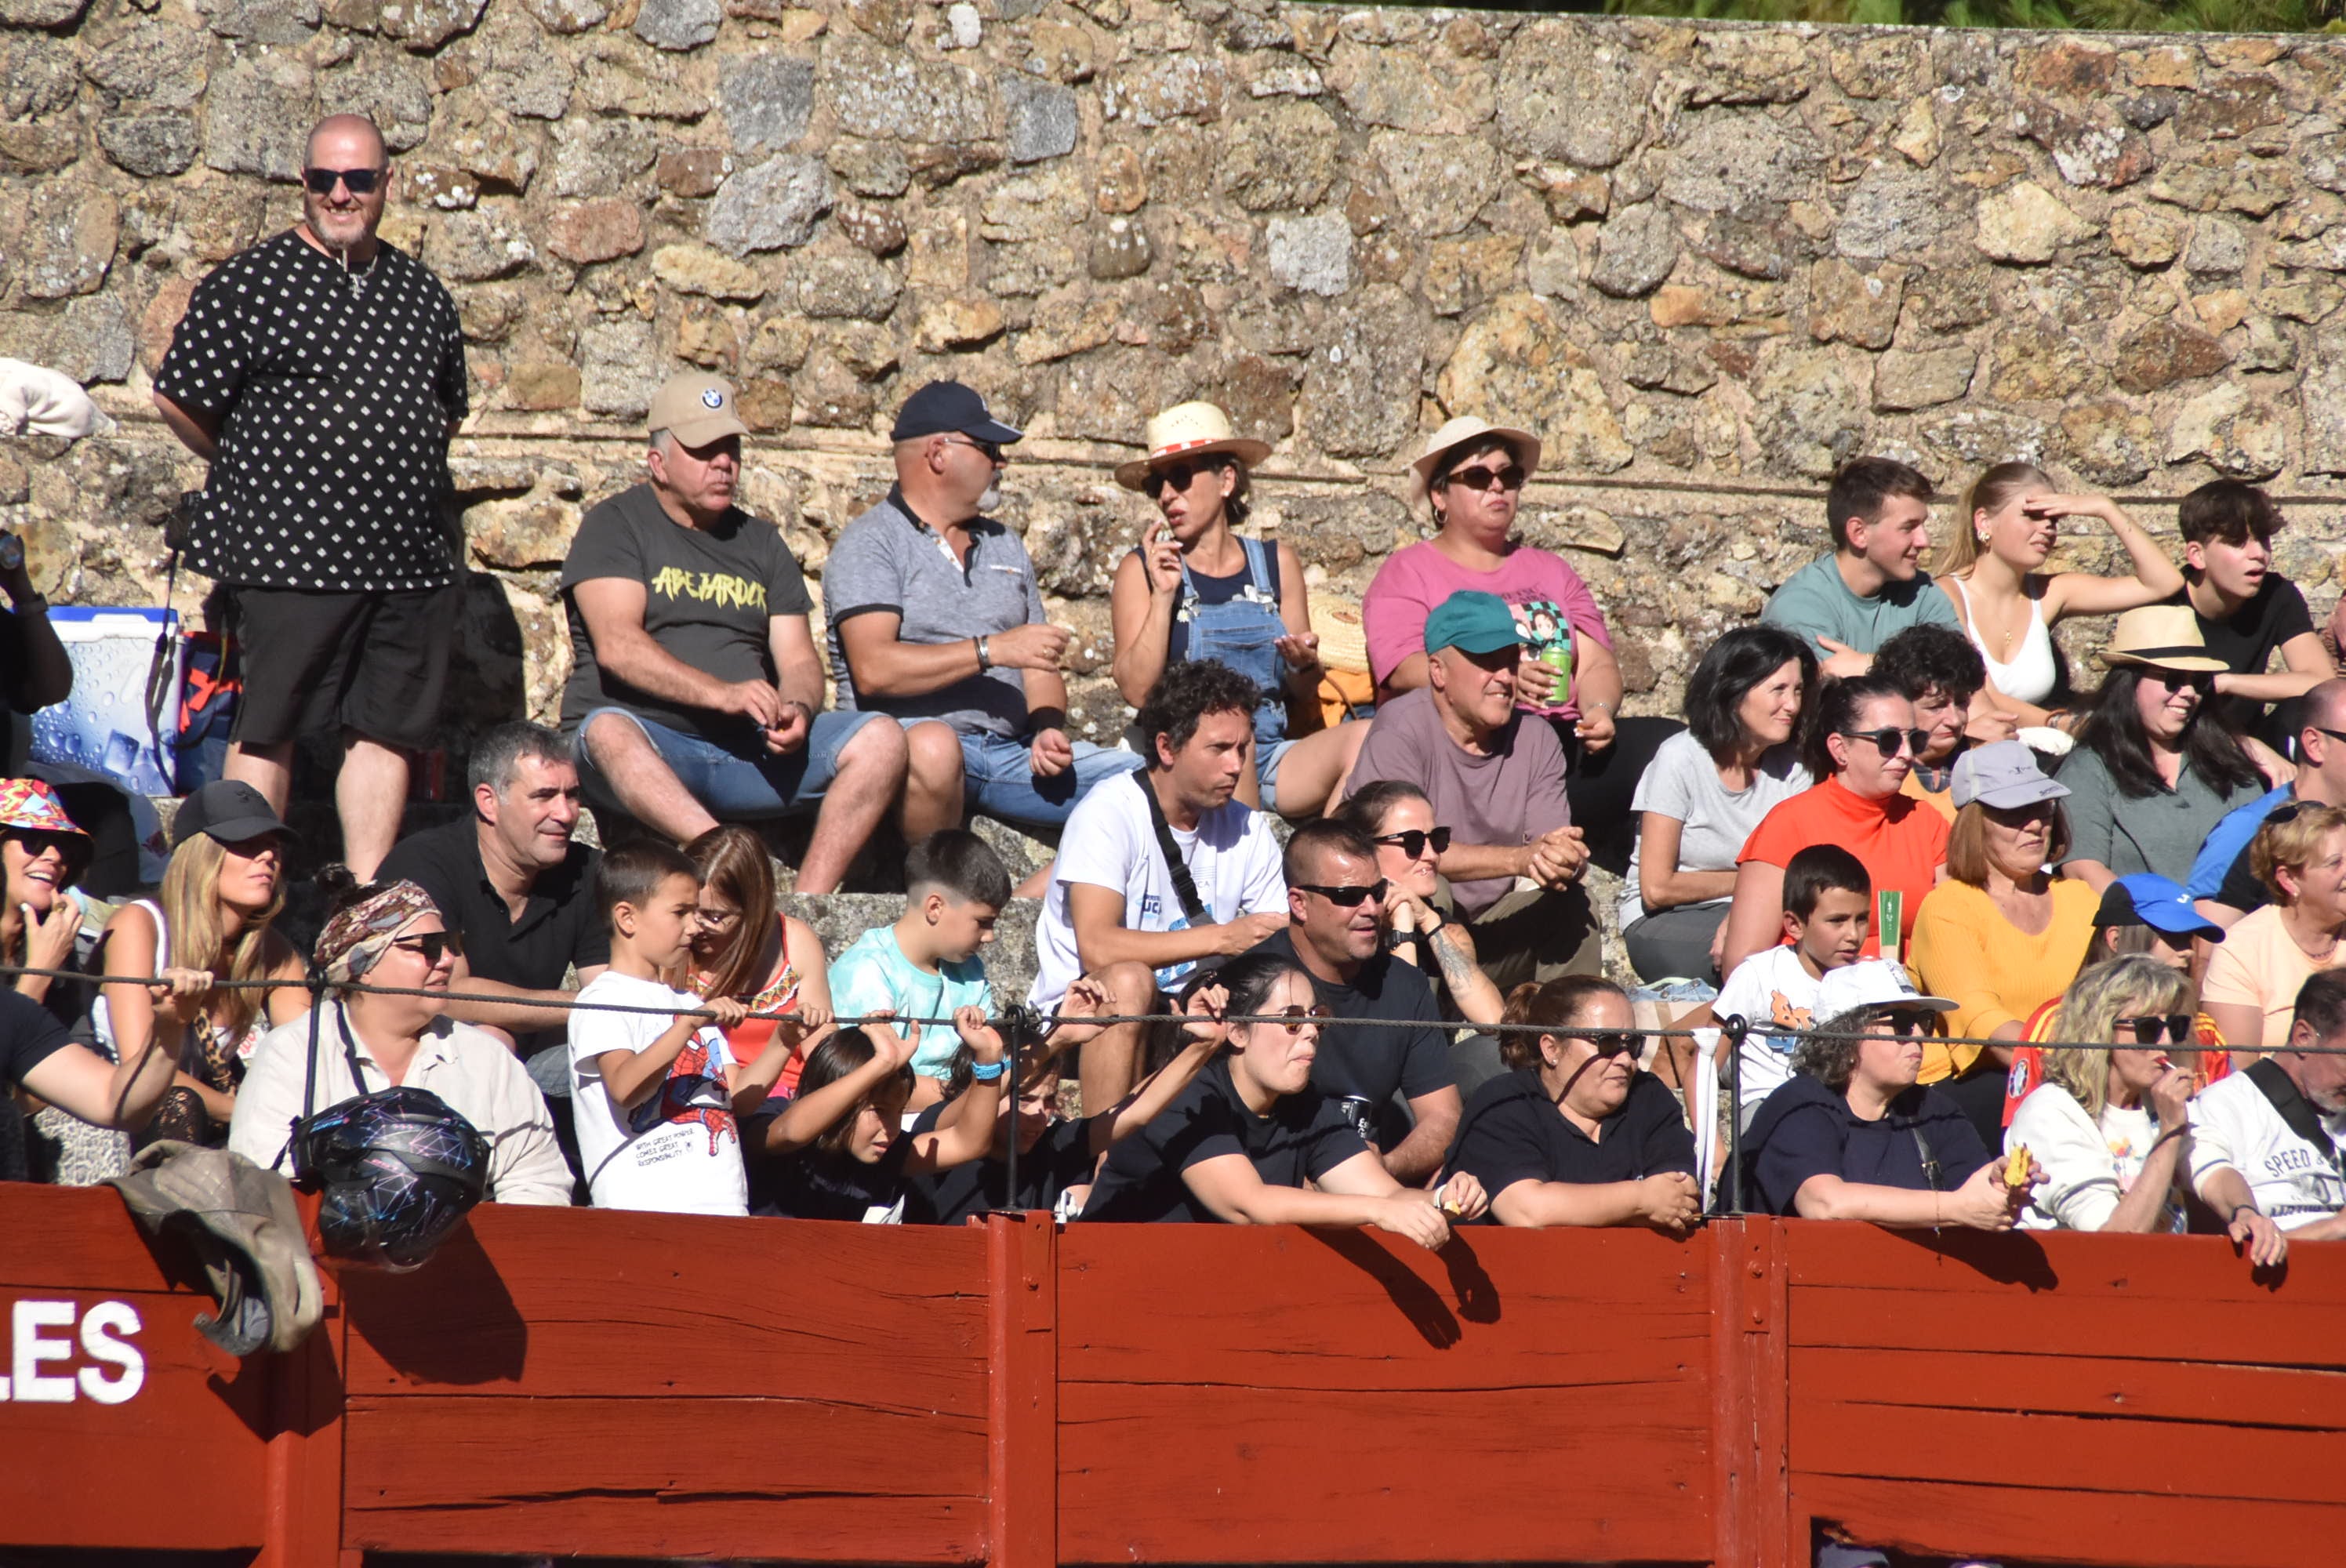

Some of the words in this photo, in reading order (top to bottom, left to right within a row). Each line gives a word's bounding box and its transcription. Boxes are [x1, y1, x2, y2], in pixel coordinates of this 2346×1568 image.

[636, 1147, 658, 1159] COMES
[659, 1142, 678, 1152] GREAT
[653, 1134, 672, 1145] GREAT
[2264, 1149, 2312, 1178] SPEED
[0, 1300, 145, 1405] ES
